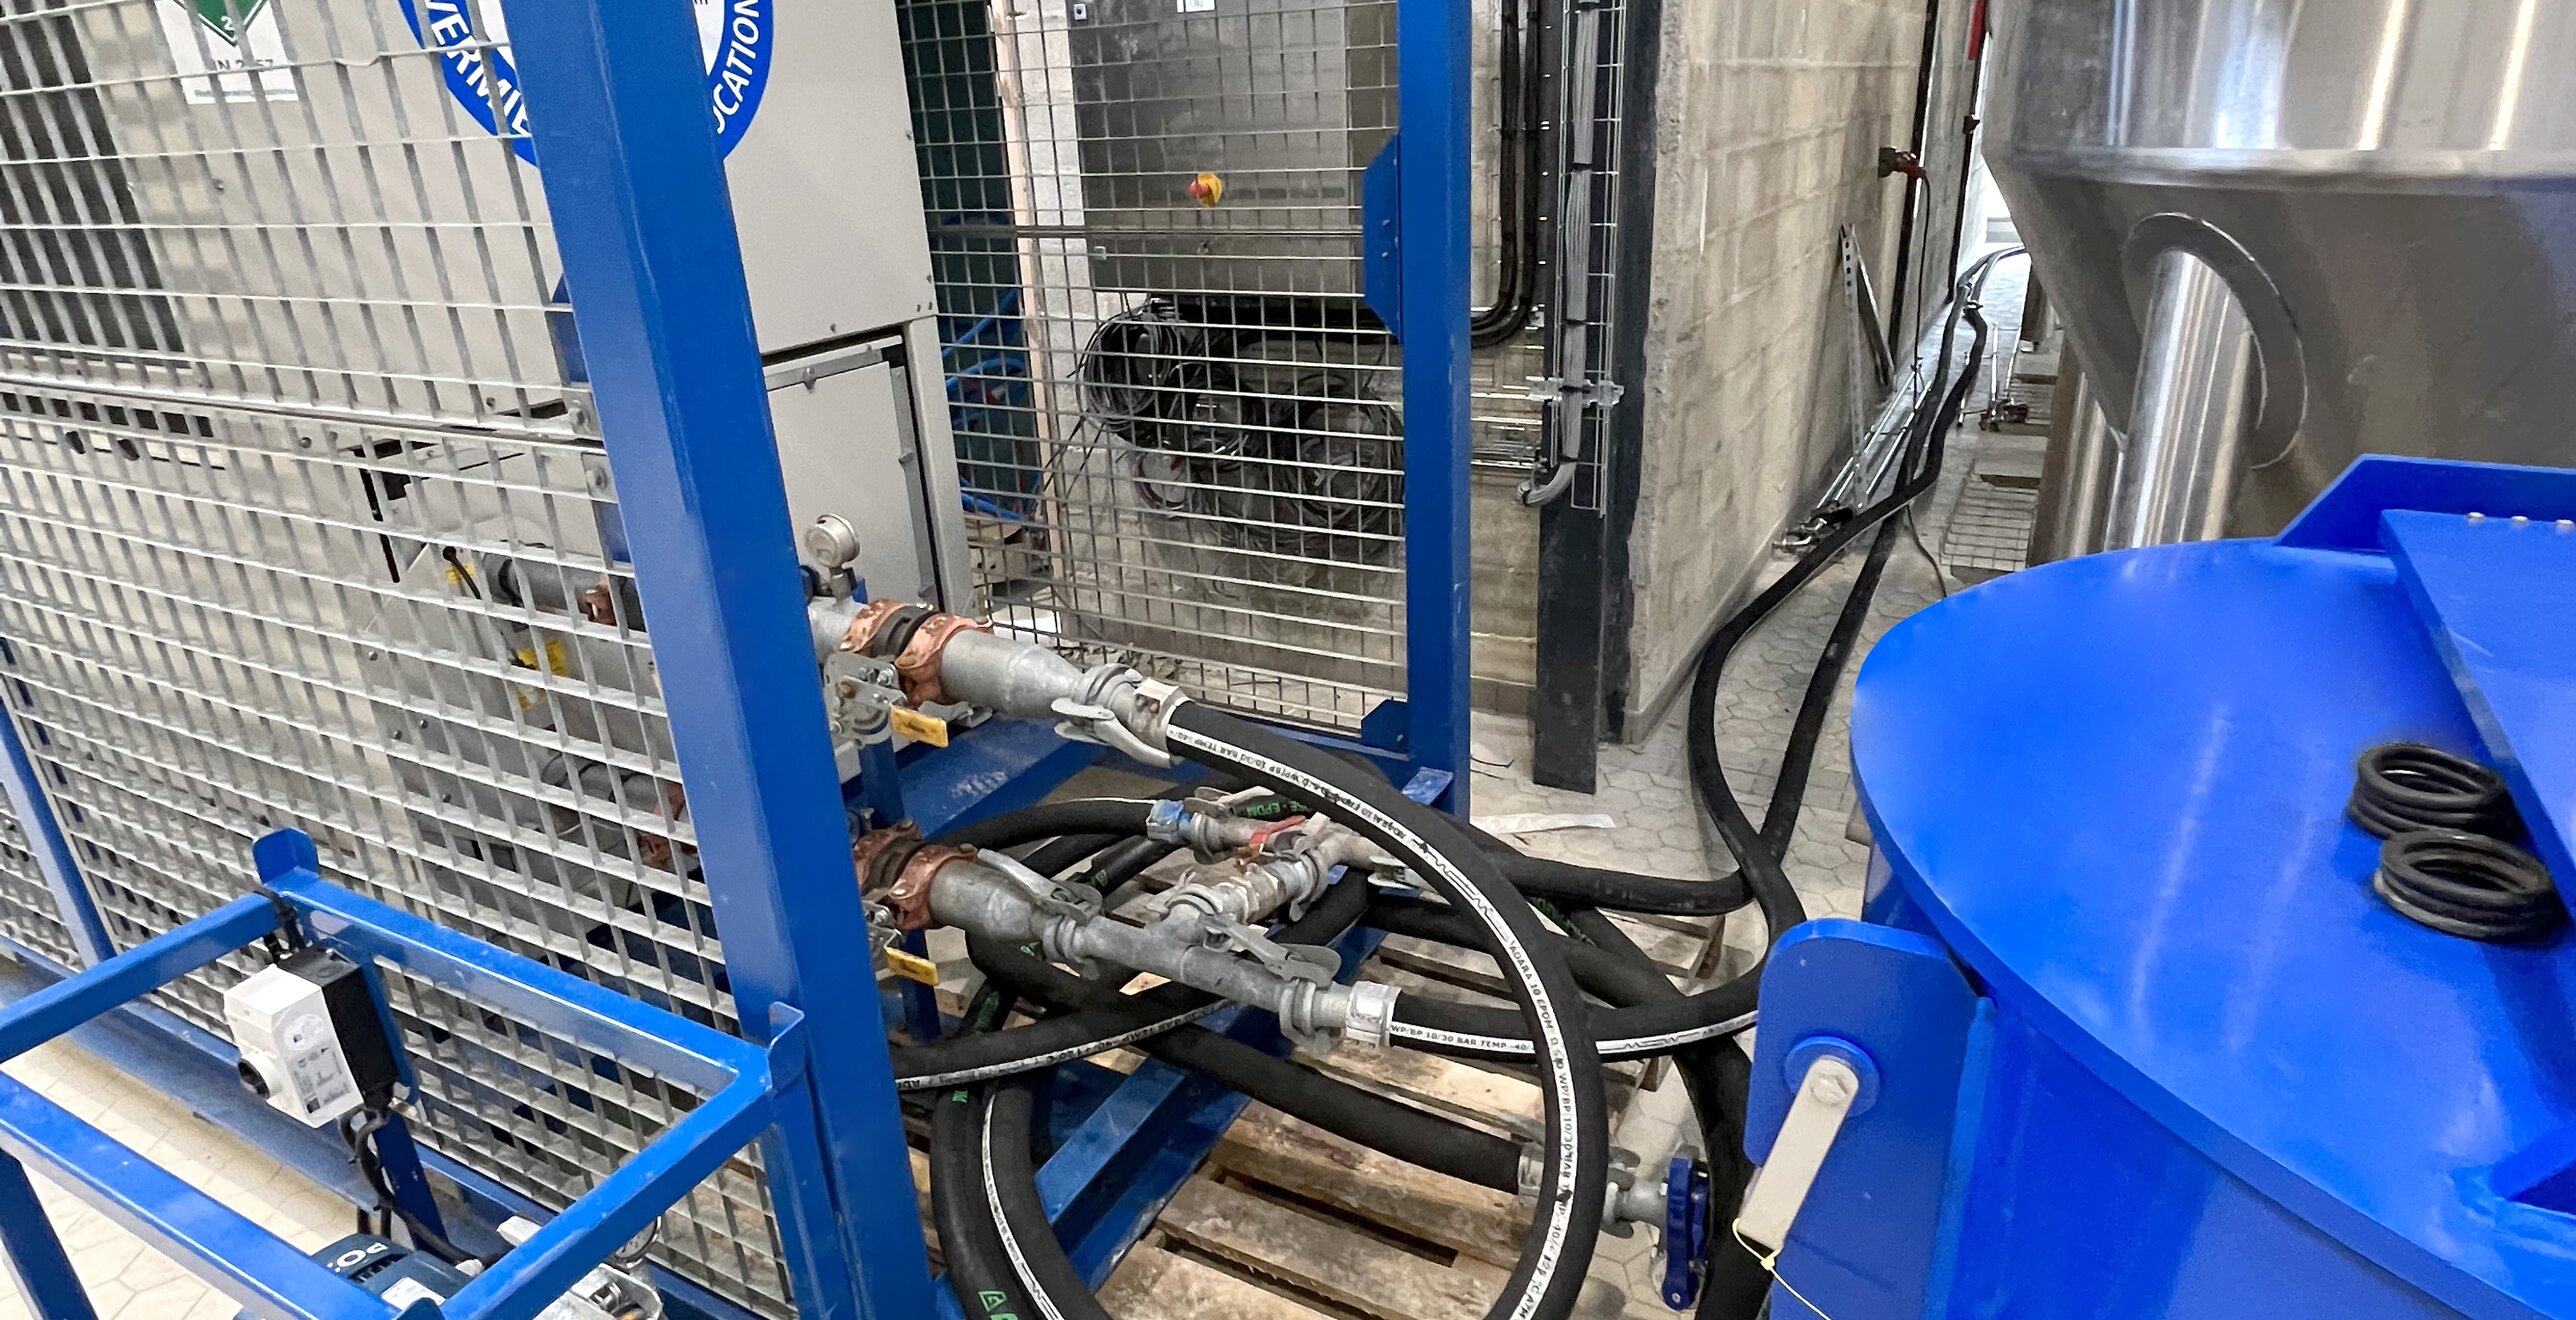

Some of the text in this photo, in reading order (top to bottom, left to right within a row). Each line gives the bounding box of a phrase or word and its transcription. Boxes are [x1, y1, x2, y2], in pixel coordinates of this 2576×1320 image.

[1194, 738, 1218, 751] TEMP
[1220, 747, 1238, 758] BAR
[1247, 803, 1280, 817] EPDM
[1391, 1025, 1424, 1036] WP/BP
[1426, 1032, 1454, 1042] 10/30
[1457, 1037, 1477, 1045] BAR
[1481, 1040, 1507, 1049] TEMP
[1530, 983, 1541, 997] 10
[1536, 998, 1554, 1030] EPDM
[1558, 1073, 1574, 1112] WP/BP
